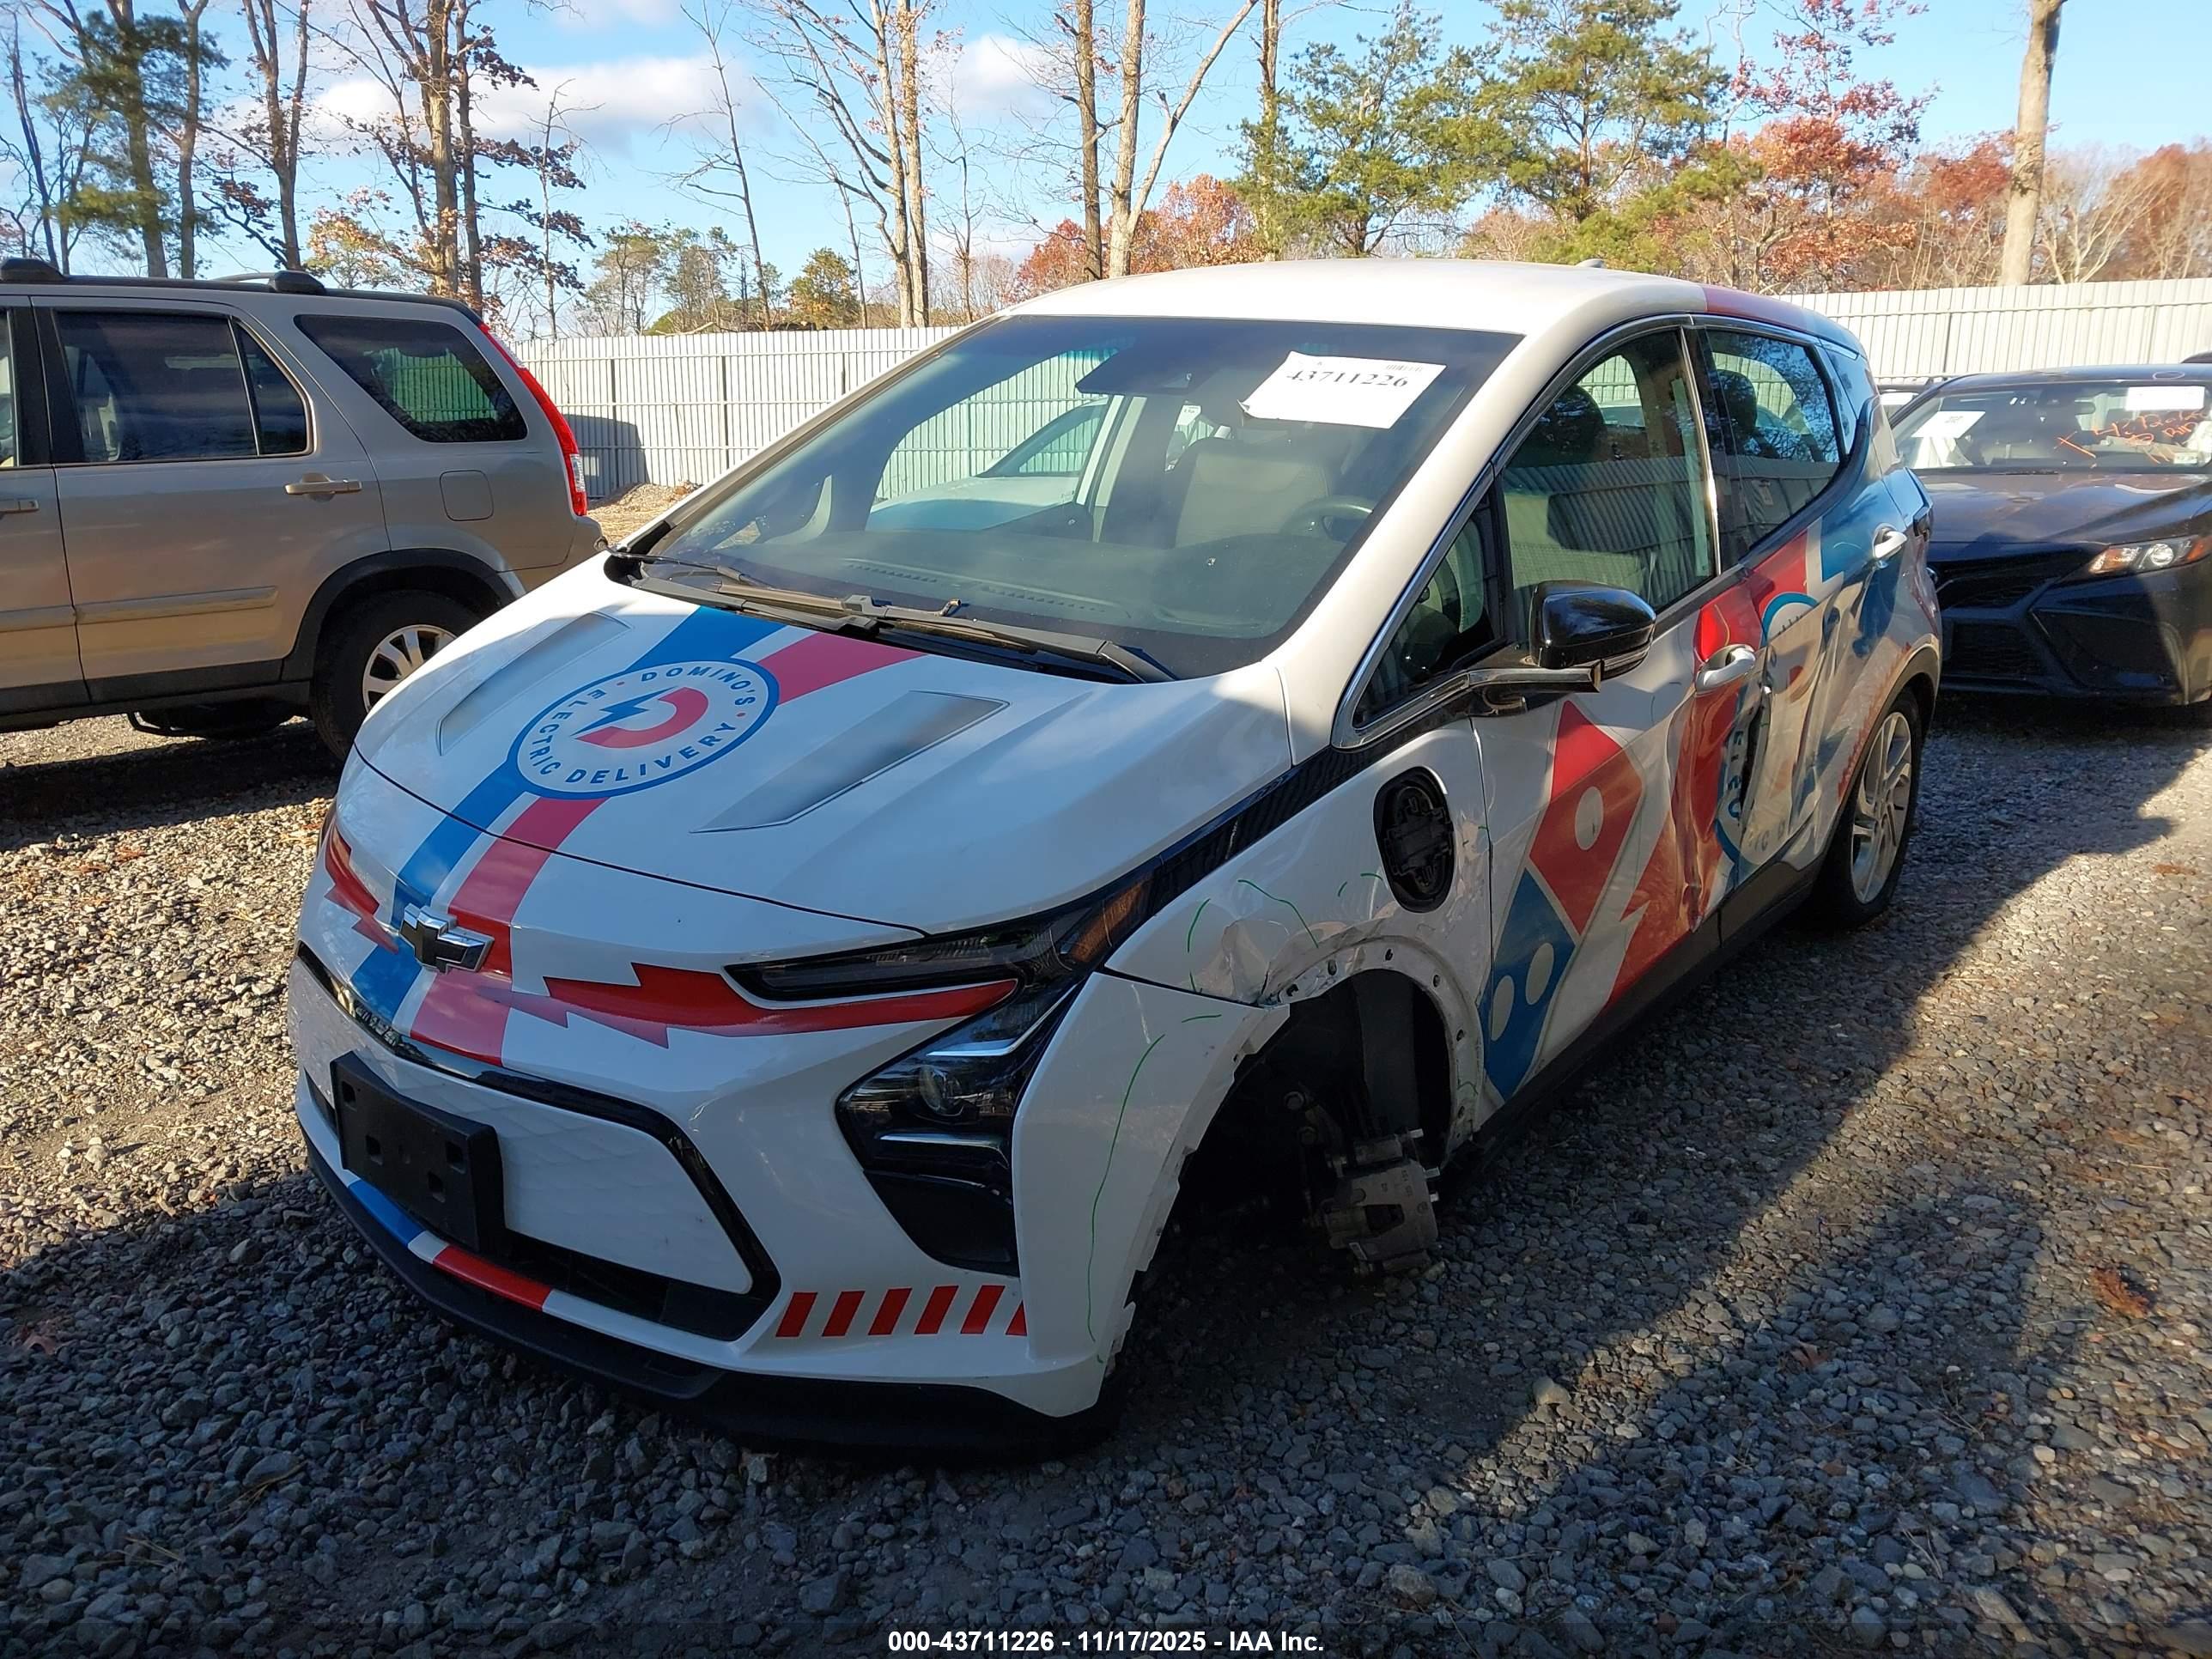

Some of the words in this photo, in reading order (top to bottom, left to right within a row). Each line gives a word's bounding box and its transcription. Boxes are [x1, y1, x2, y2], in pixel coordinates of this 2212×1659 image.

[1286, 369, 1409, 388] 43711226
[641, 665, 757, 708] DOMINO'S
[528, 688, 607, 776] ELECTRIC
[564, 721, 737, 784] DELIVERY
